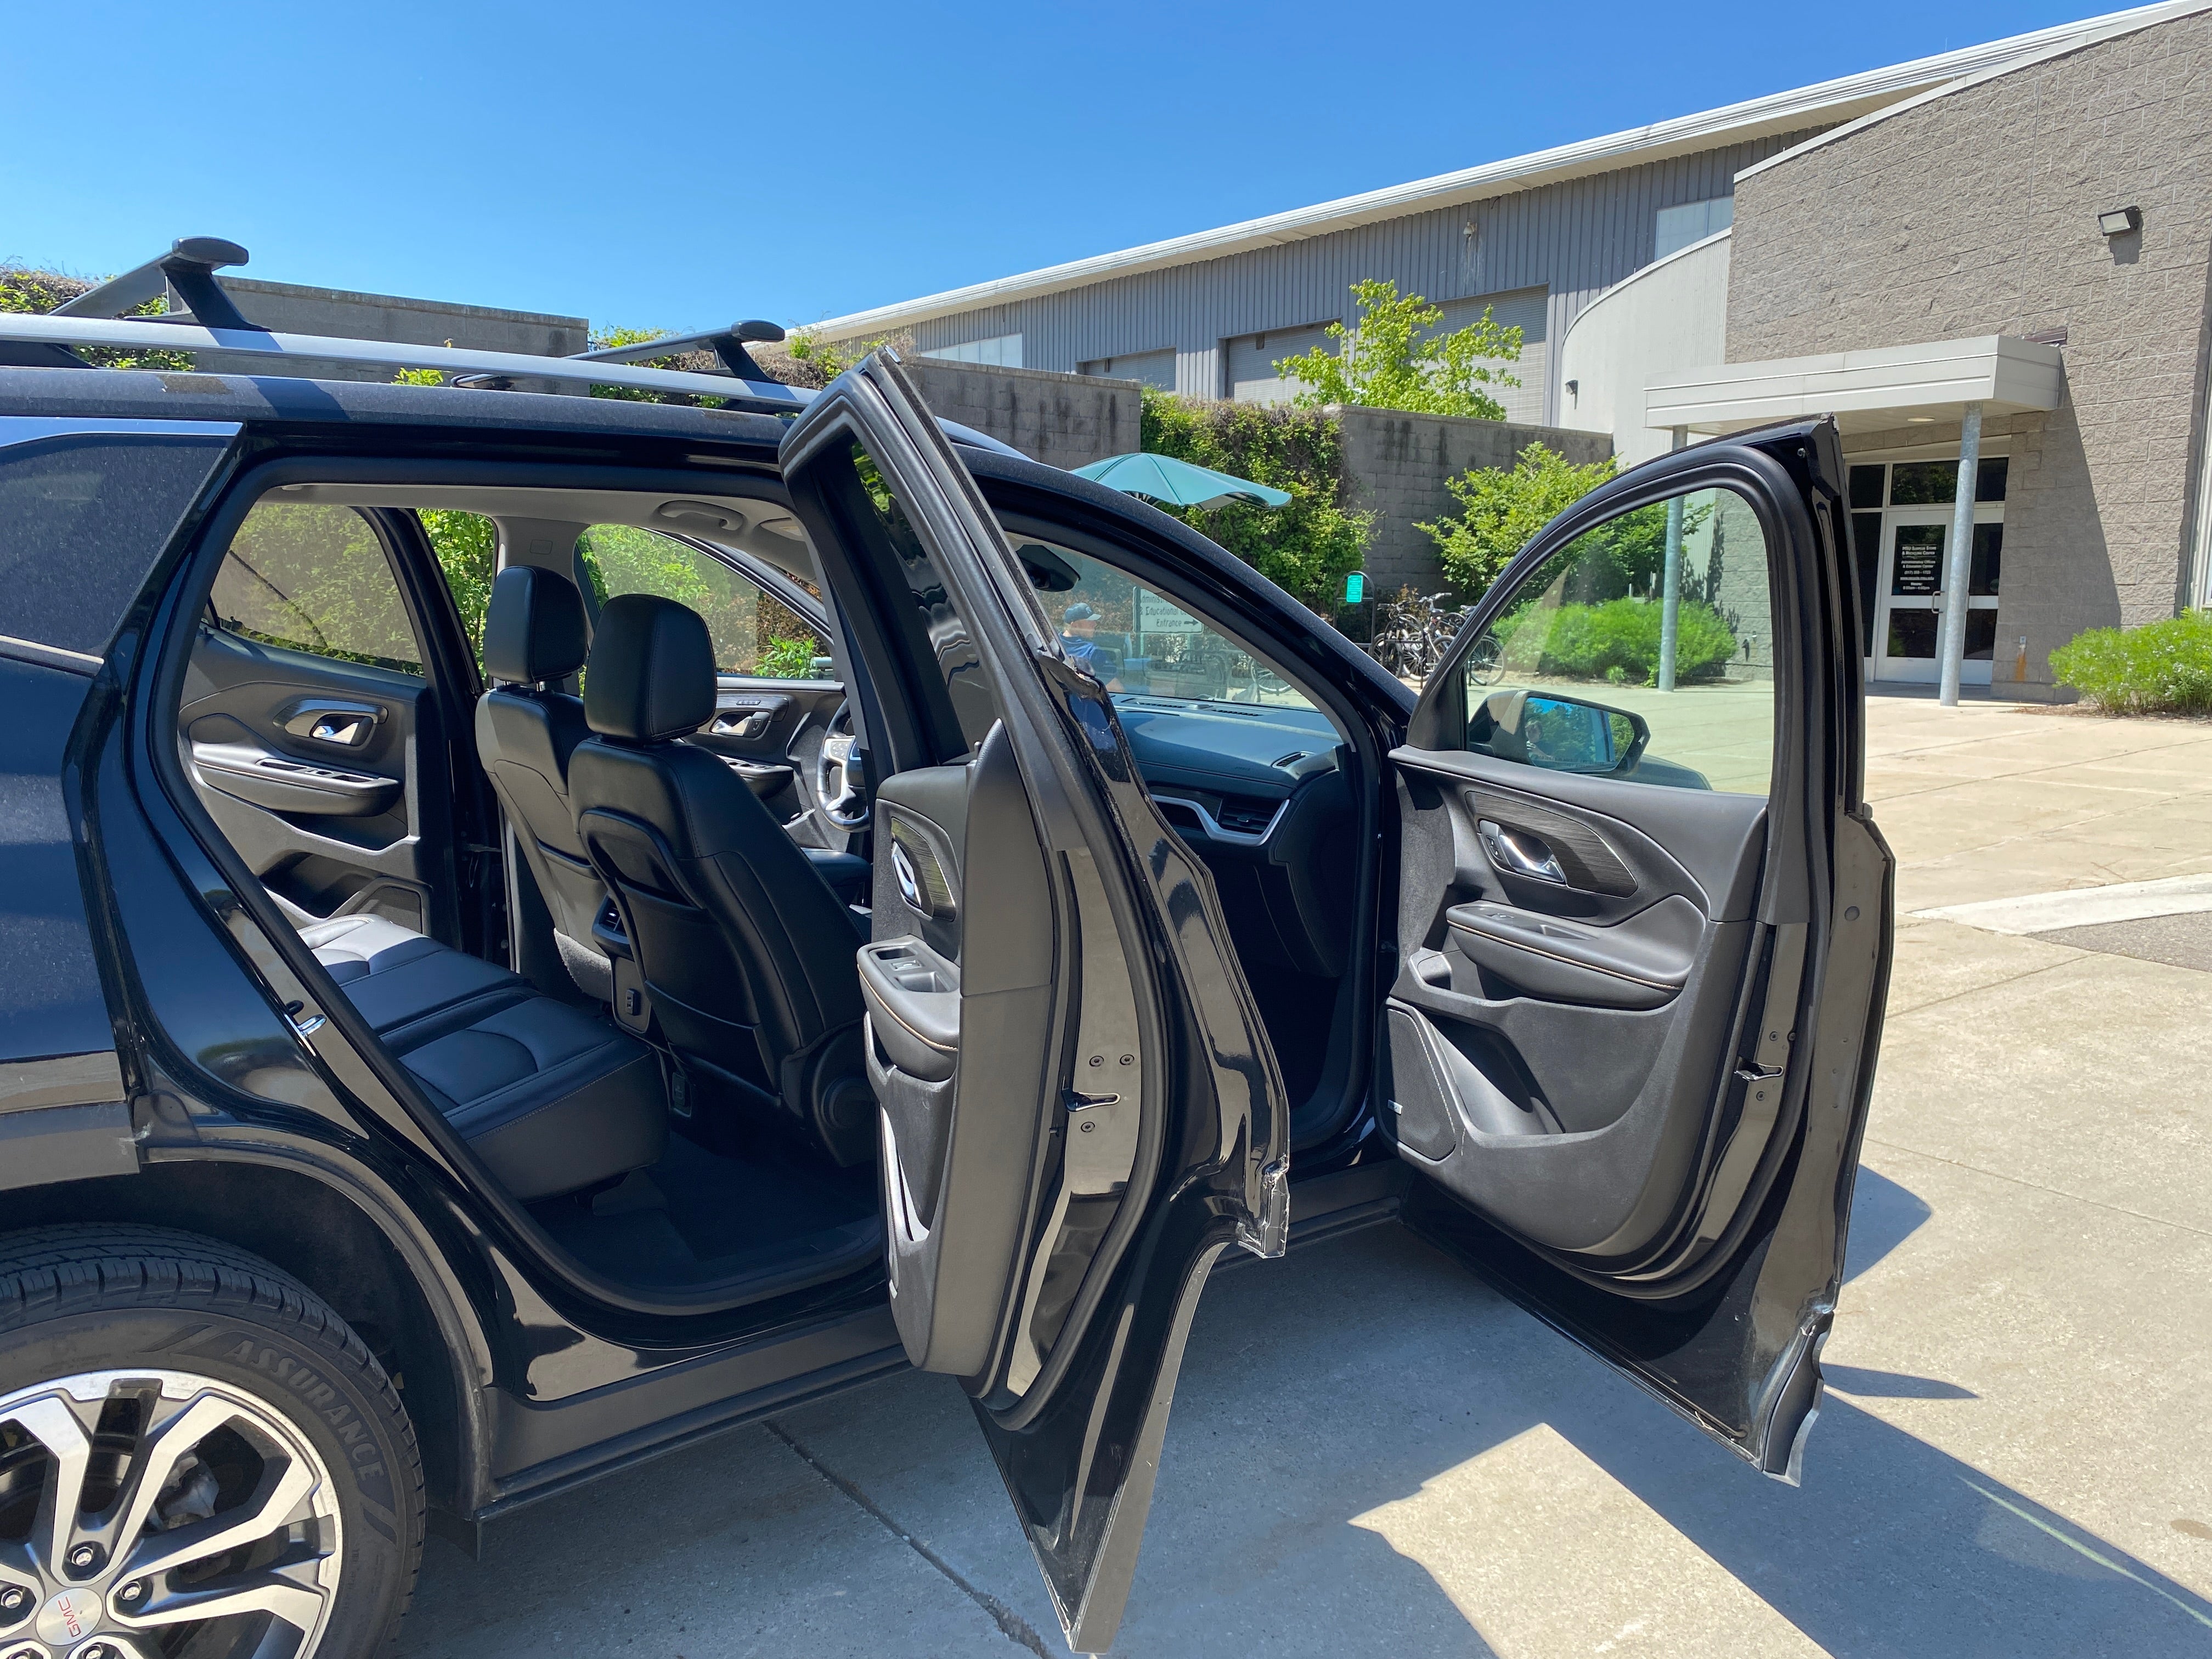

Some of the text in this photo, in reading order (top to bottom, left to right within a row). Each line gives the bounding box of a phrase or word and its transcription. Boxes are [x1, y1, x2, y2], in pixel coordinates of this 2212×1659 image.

[1156, 618, 1182, 627] Entrance
[222, 1340, 384, 1480] ASSURANCE
[58, 1596, 81, 1638] GMC
